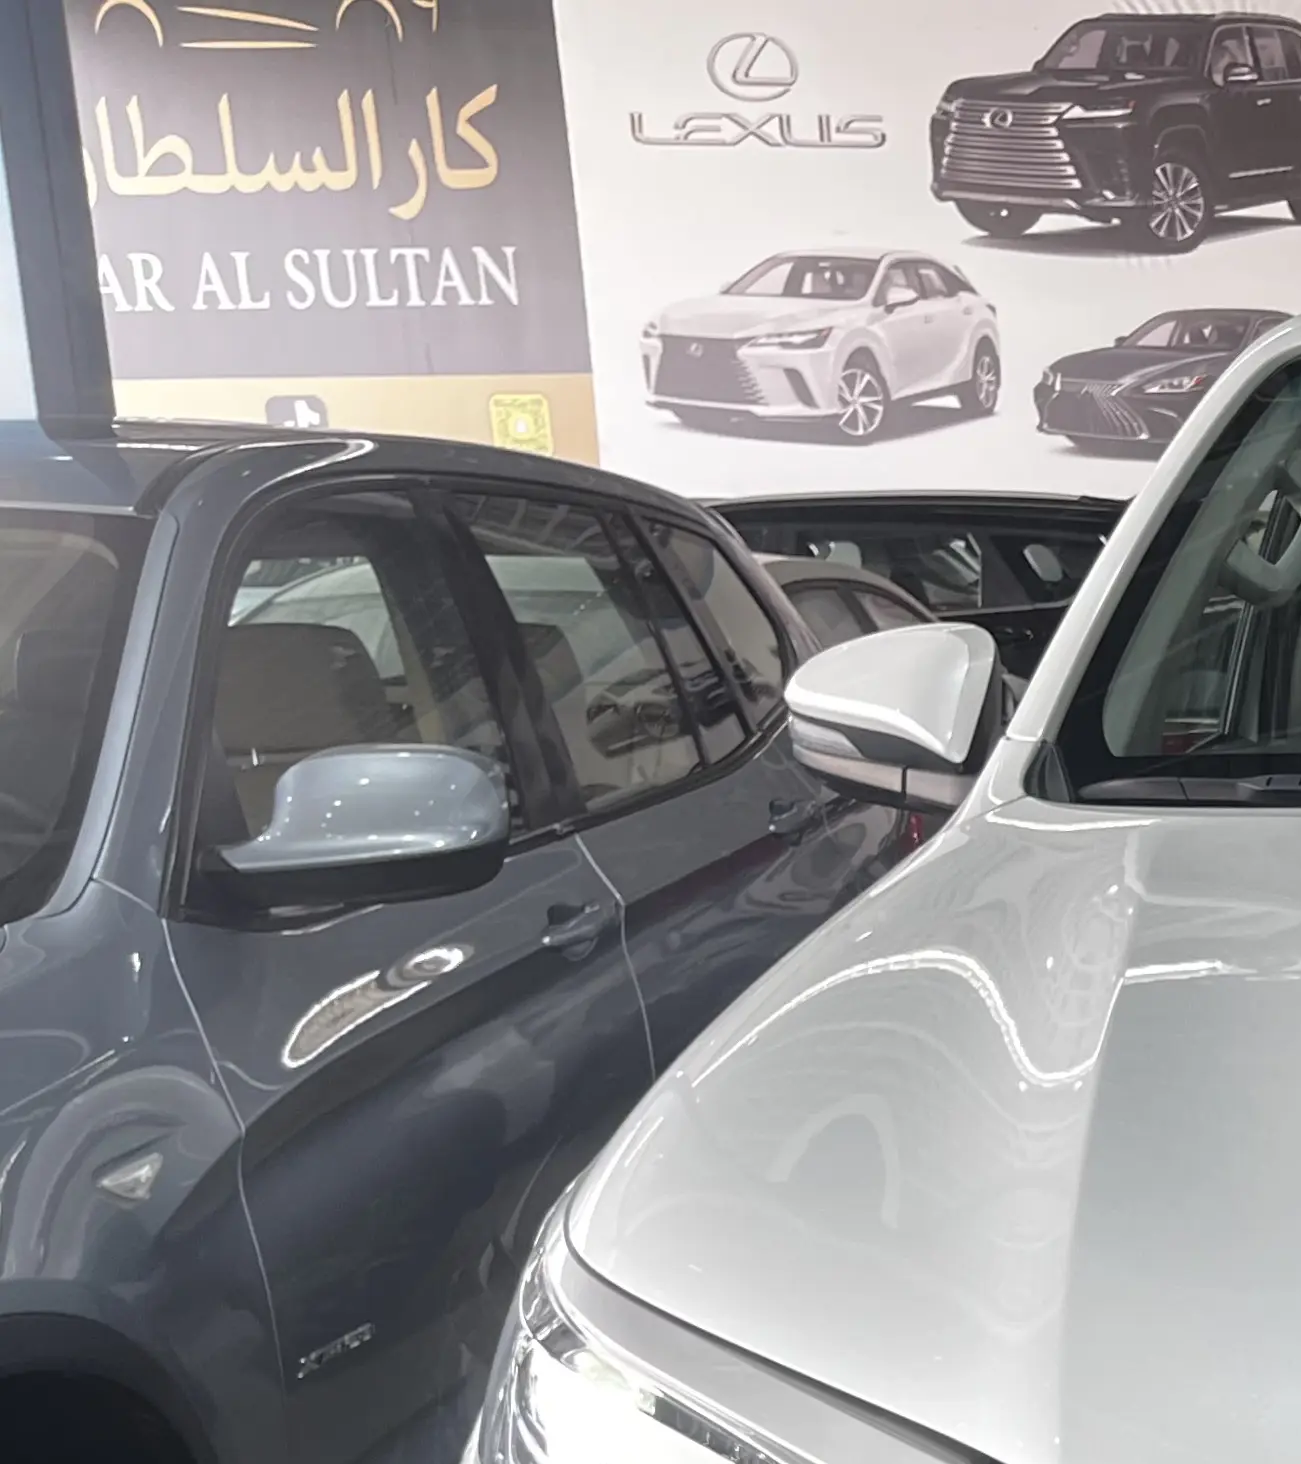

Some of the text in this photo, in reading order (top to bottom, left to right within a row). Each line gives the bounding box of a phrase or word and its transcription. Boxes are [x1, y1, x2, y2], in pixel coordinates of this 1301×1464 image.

[388, 83, 499, 221] كار
[629, 112, 887, 149] LEXUS
[98, 245, 520, 313] AR AL SULTAN
